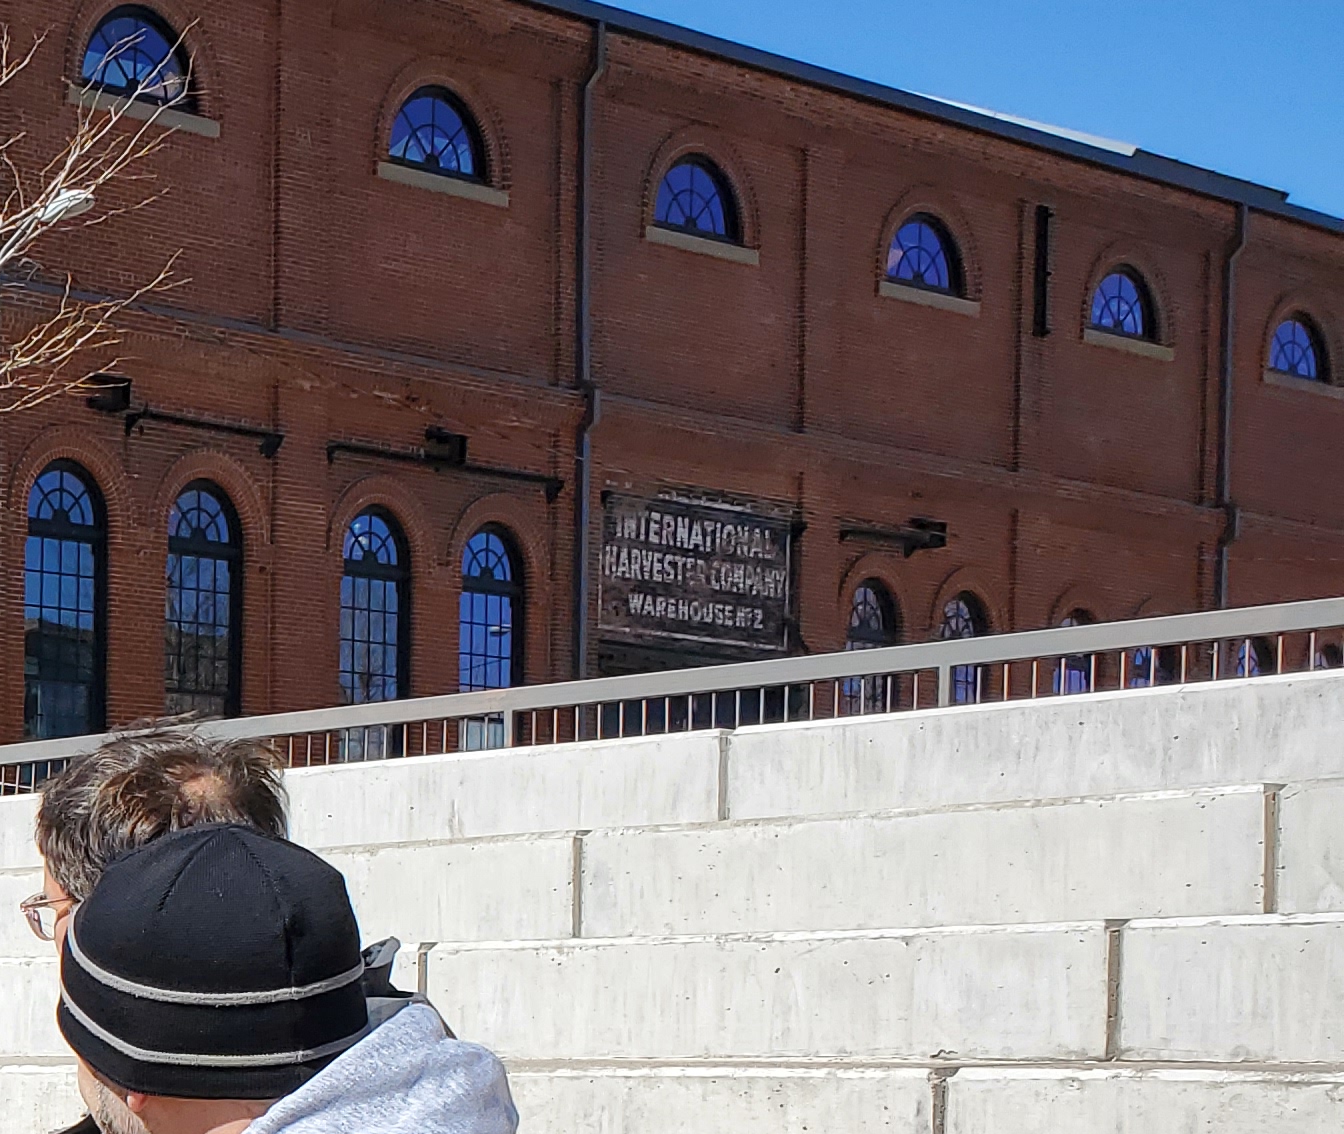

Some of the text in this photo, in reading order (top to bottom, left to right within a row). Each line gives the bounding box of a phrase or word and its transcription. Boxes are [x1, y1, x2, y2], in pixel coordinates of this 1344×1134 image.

[615, 509, 778, 560] INTERNATIONAL
[604, 544, 786, 599] HARVESTER COMPANY
[628, 592, 734, 628] WAREHOUSE
